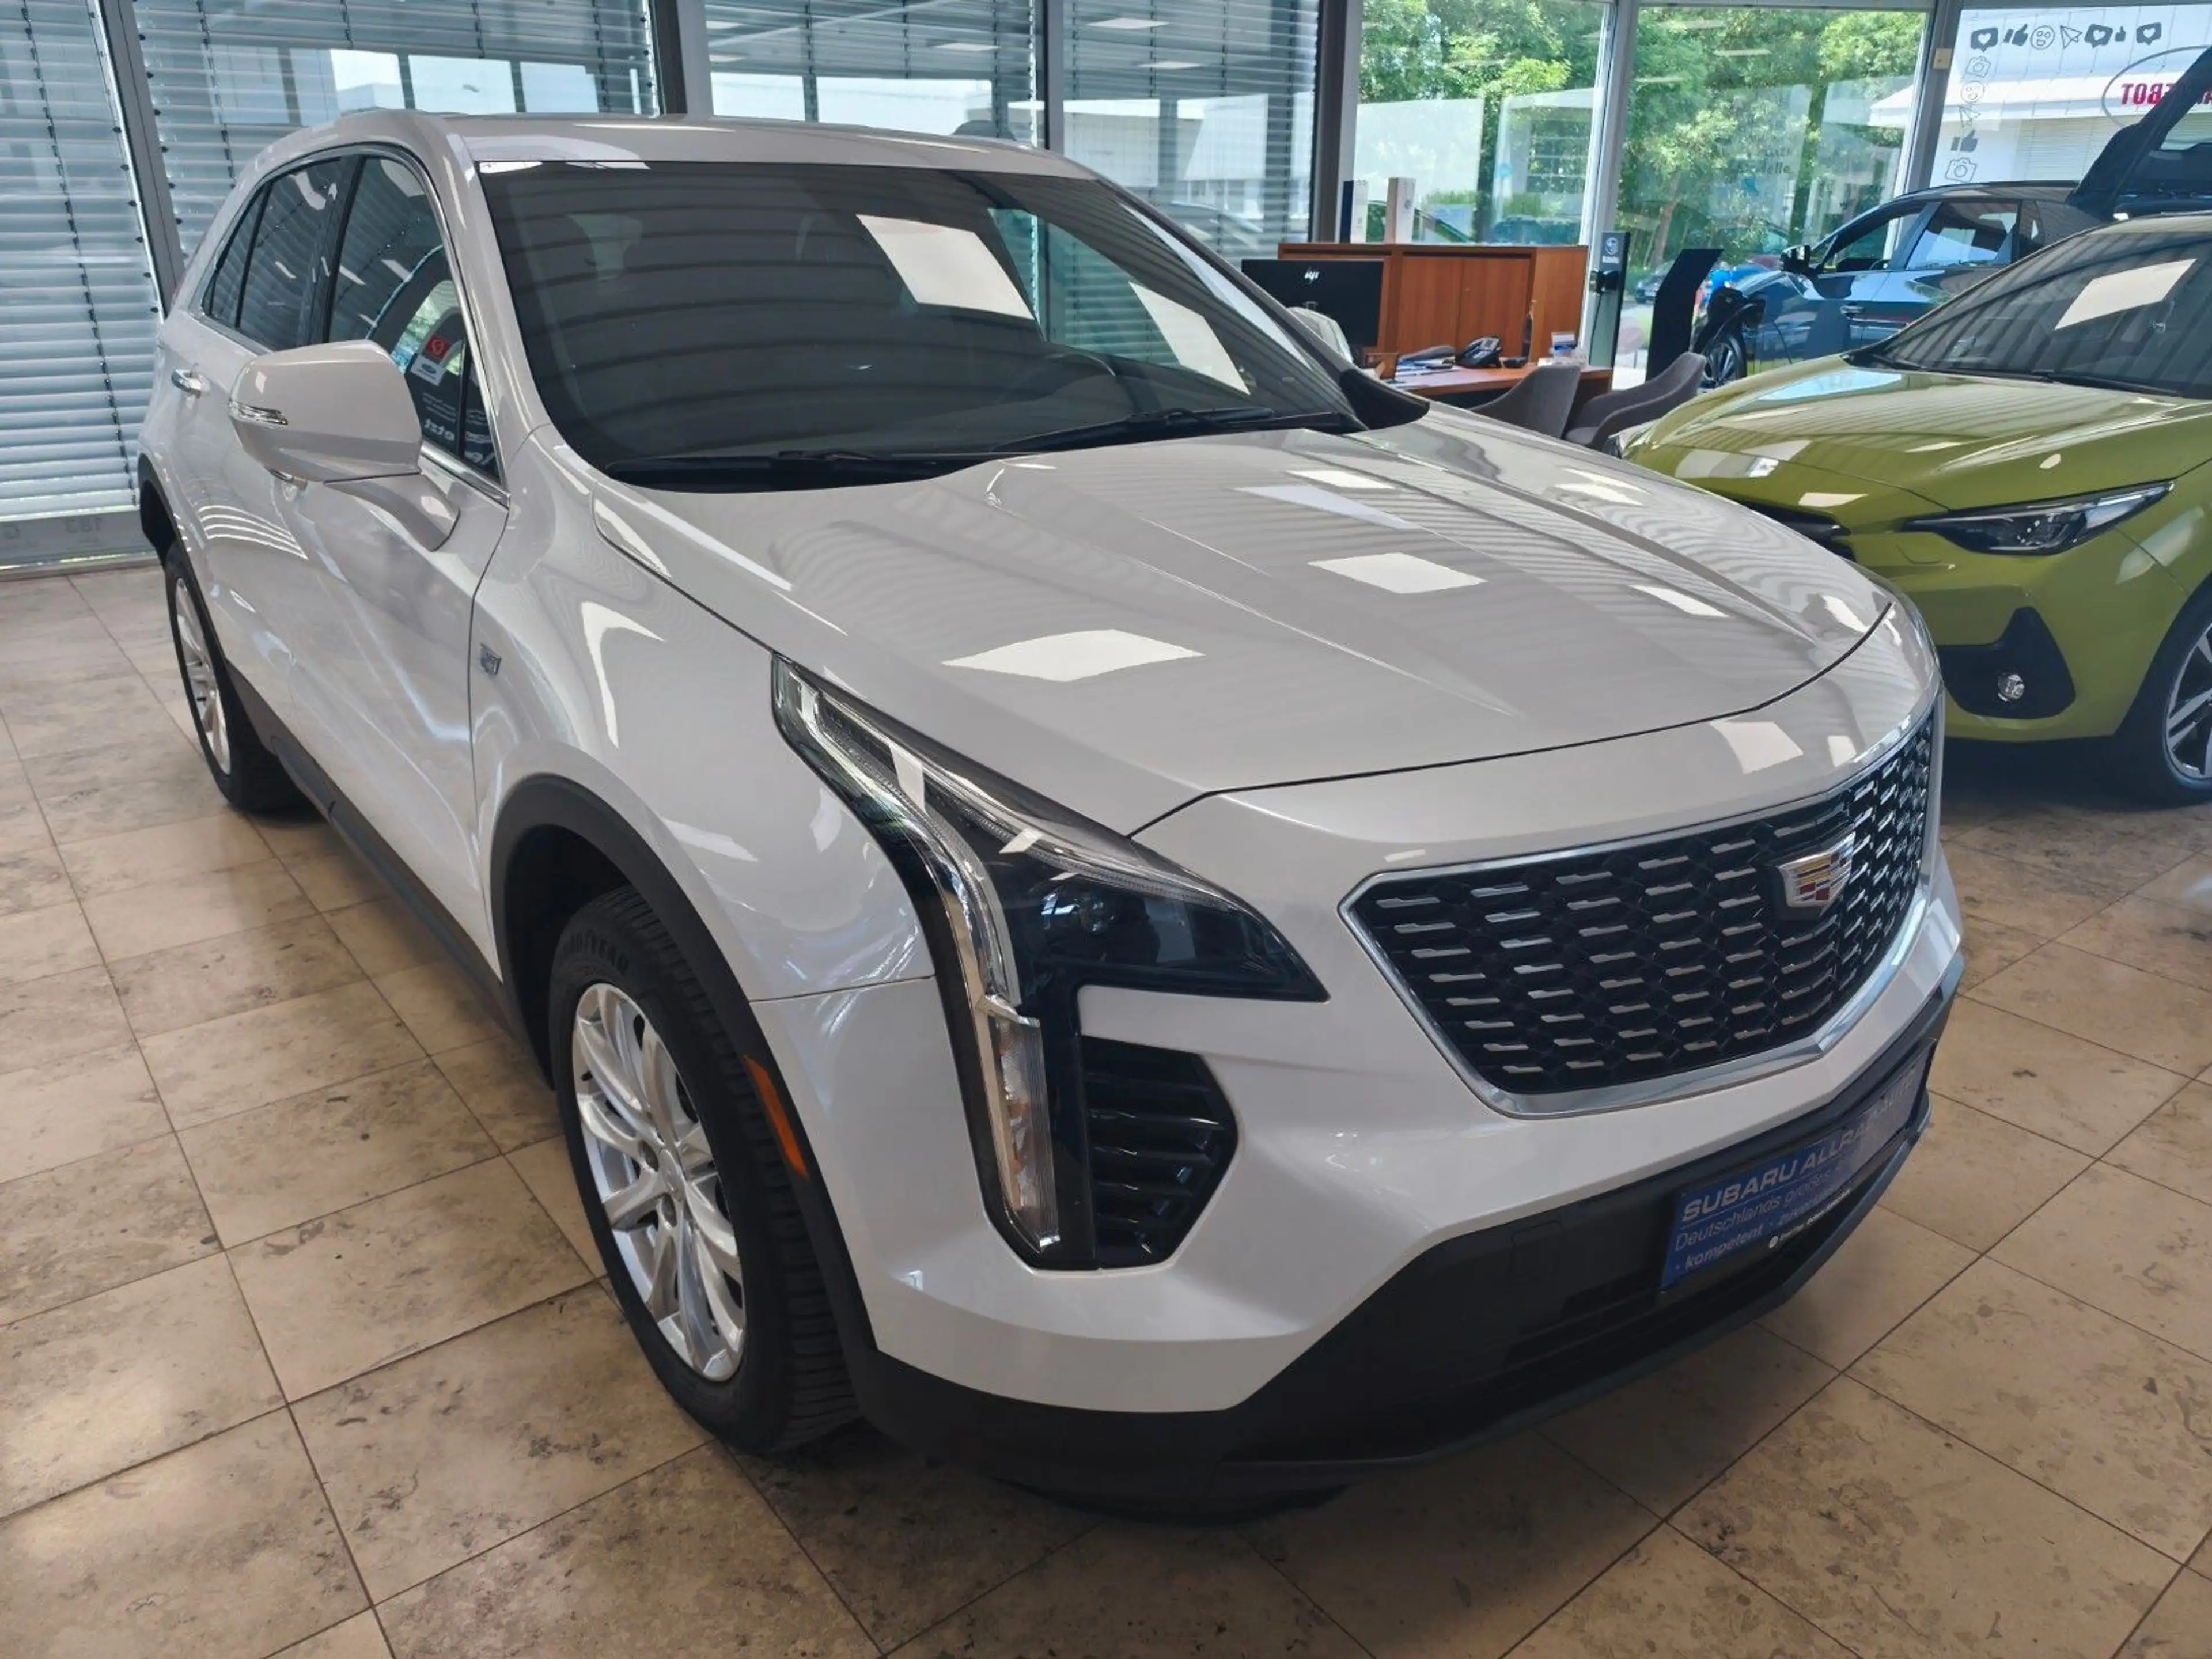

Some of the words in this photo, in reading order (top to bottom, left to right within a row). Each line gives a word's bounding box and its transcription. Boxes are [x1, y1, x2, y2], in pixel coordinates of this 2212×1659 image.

[1681, 1159, 1798, 1222] SUBARU
[1675, 1195, 1782, 1251] Deutschlands
[1685, 1224, 1763, 1270] kompetent
